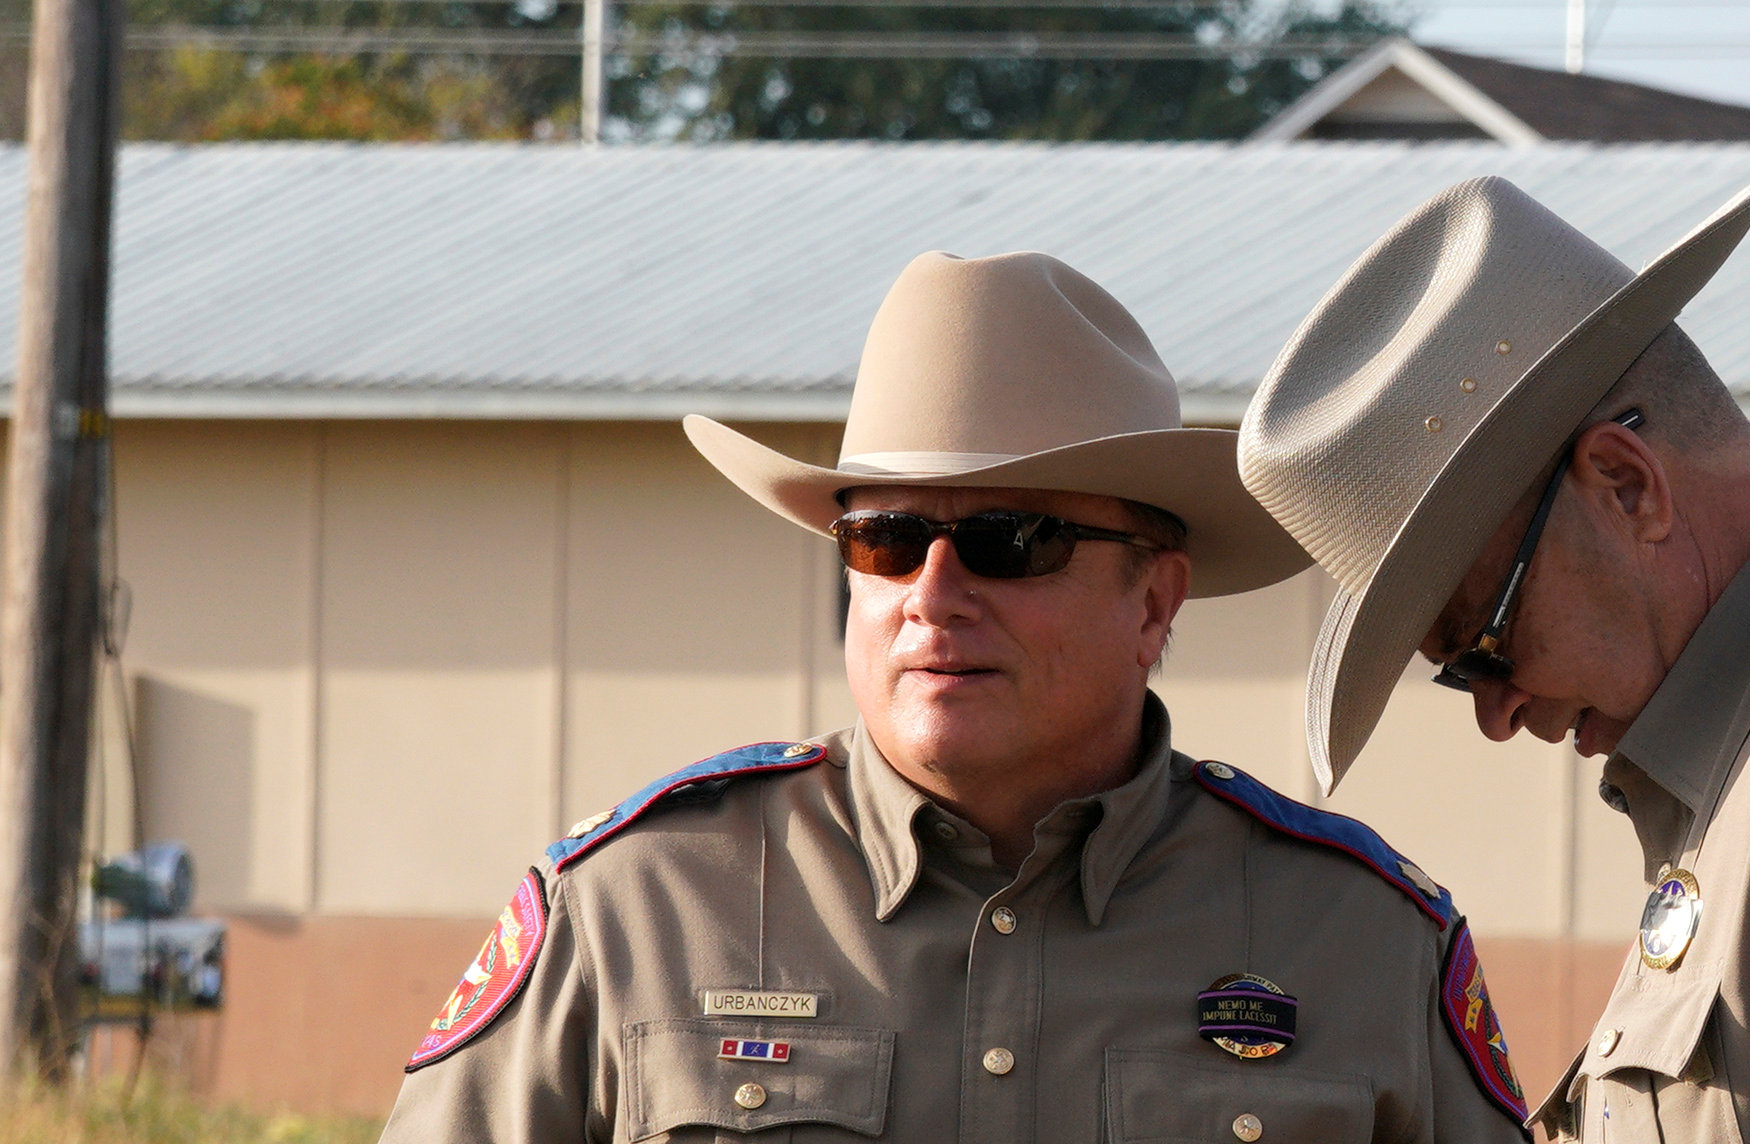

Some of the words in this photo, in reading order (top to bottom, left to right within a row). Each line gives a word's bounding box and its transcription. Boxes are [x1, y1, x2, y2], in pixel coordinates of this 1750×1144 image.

[713, 994, 811, 1012] URBANCZYK
[1217, 1000, 1246, 1010] NEMO
[1249, 1000, 1263, 1011] ME
[1202, 1010, 1238, 1021] IMPUNE
[1240, 1010, 1277, 1024] LACESSIT
